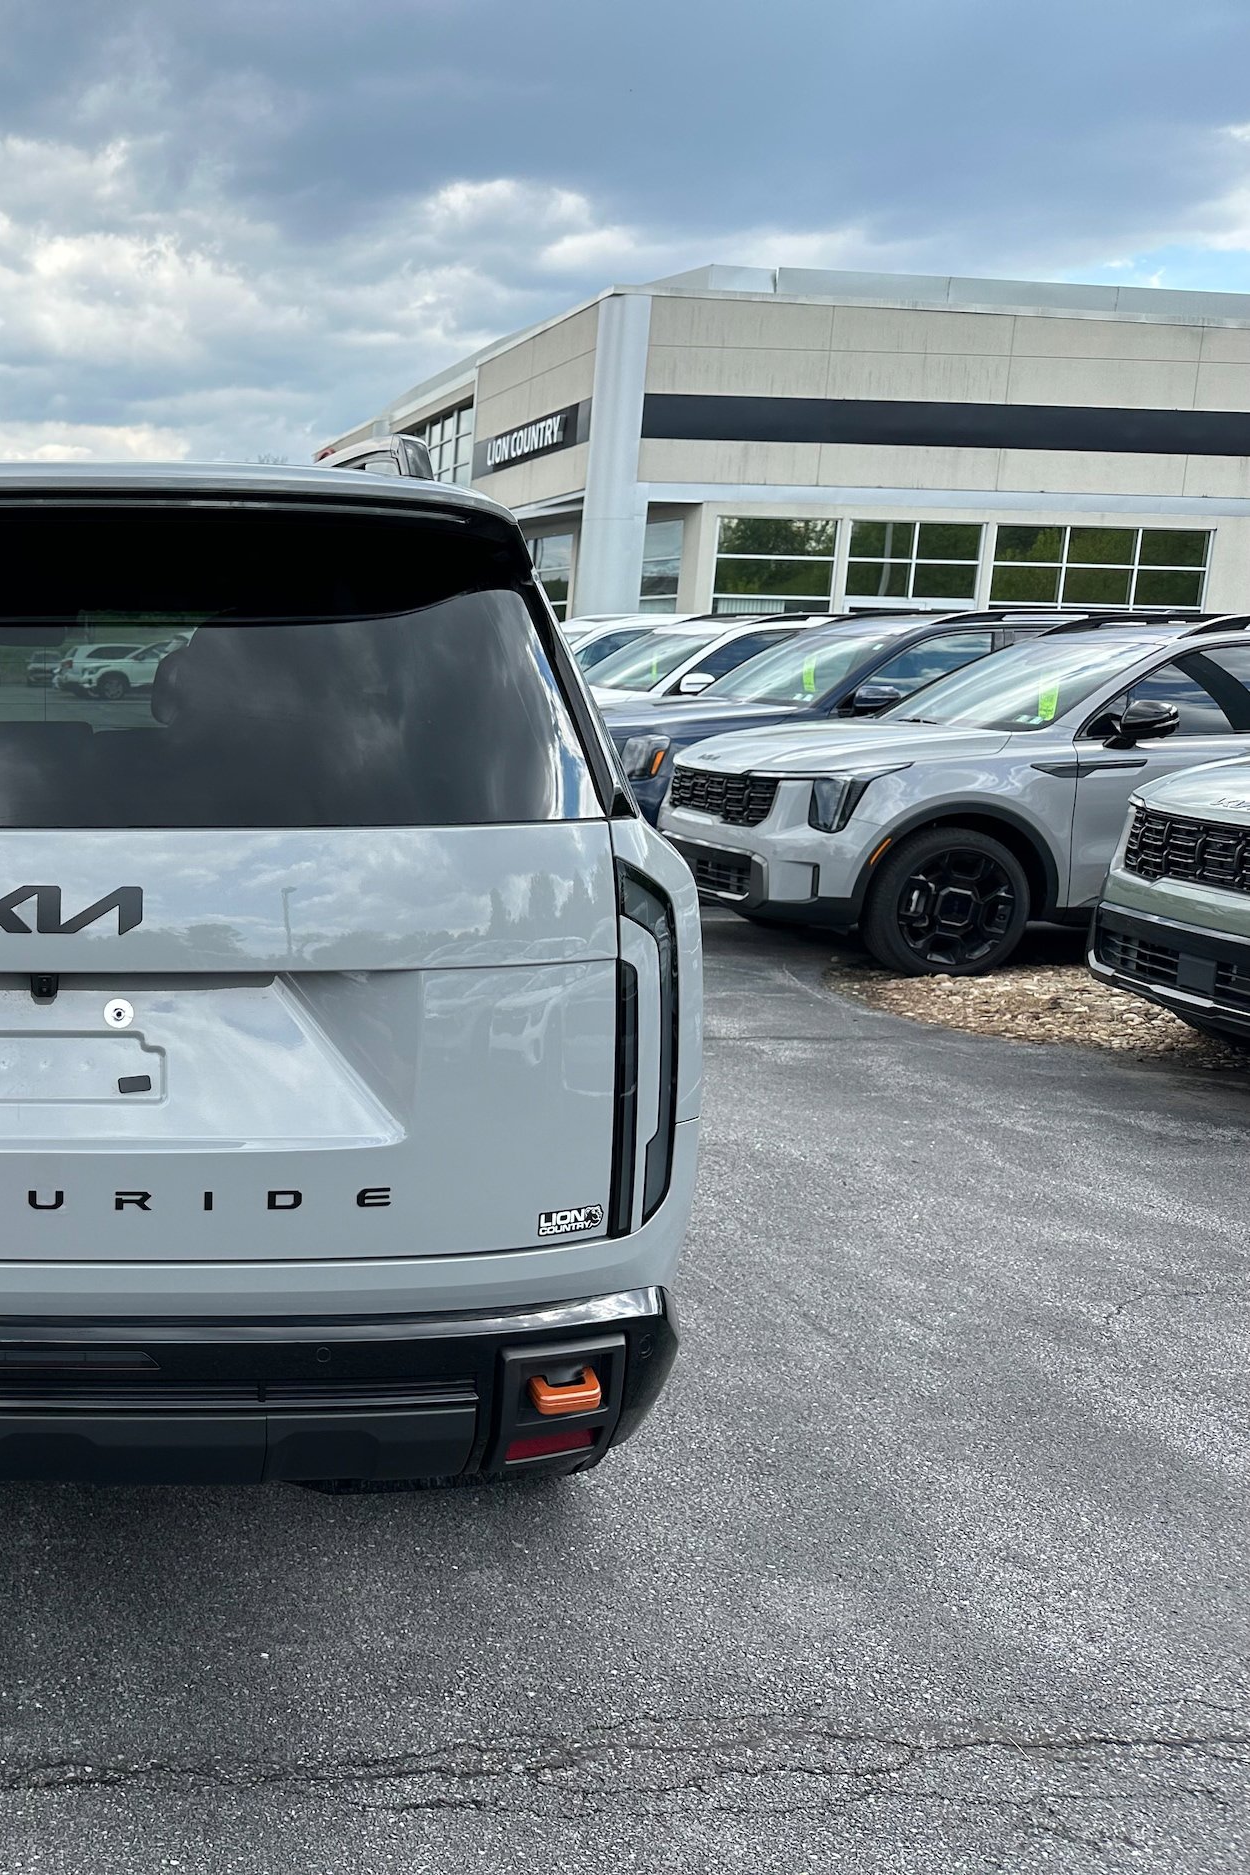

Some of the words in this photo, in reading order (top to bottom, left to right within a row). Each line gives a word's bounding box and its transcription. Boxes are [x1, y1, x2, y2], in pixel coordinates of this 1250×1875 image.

[486, 434, 511, 467] LION
[510, 415, 561, 458] COUNTRY
[539, 1219, 593, 1236] COUNTRY
[540, 1208, 586, 1228] LION
